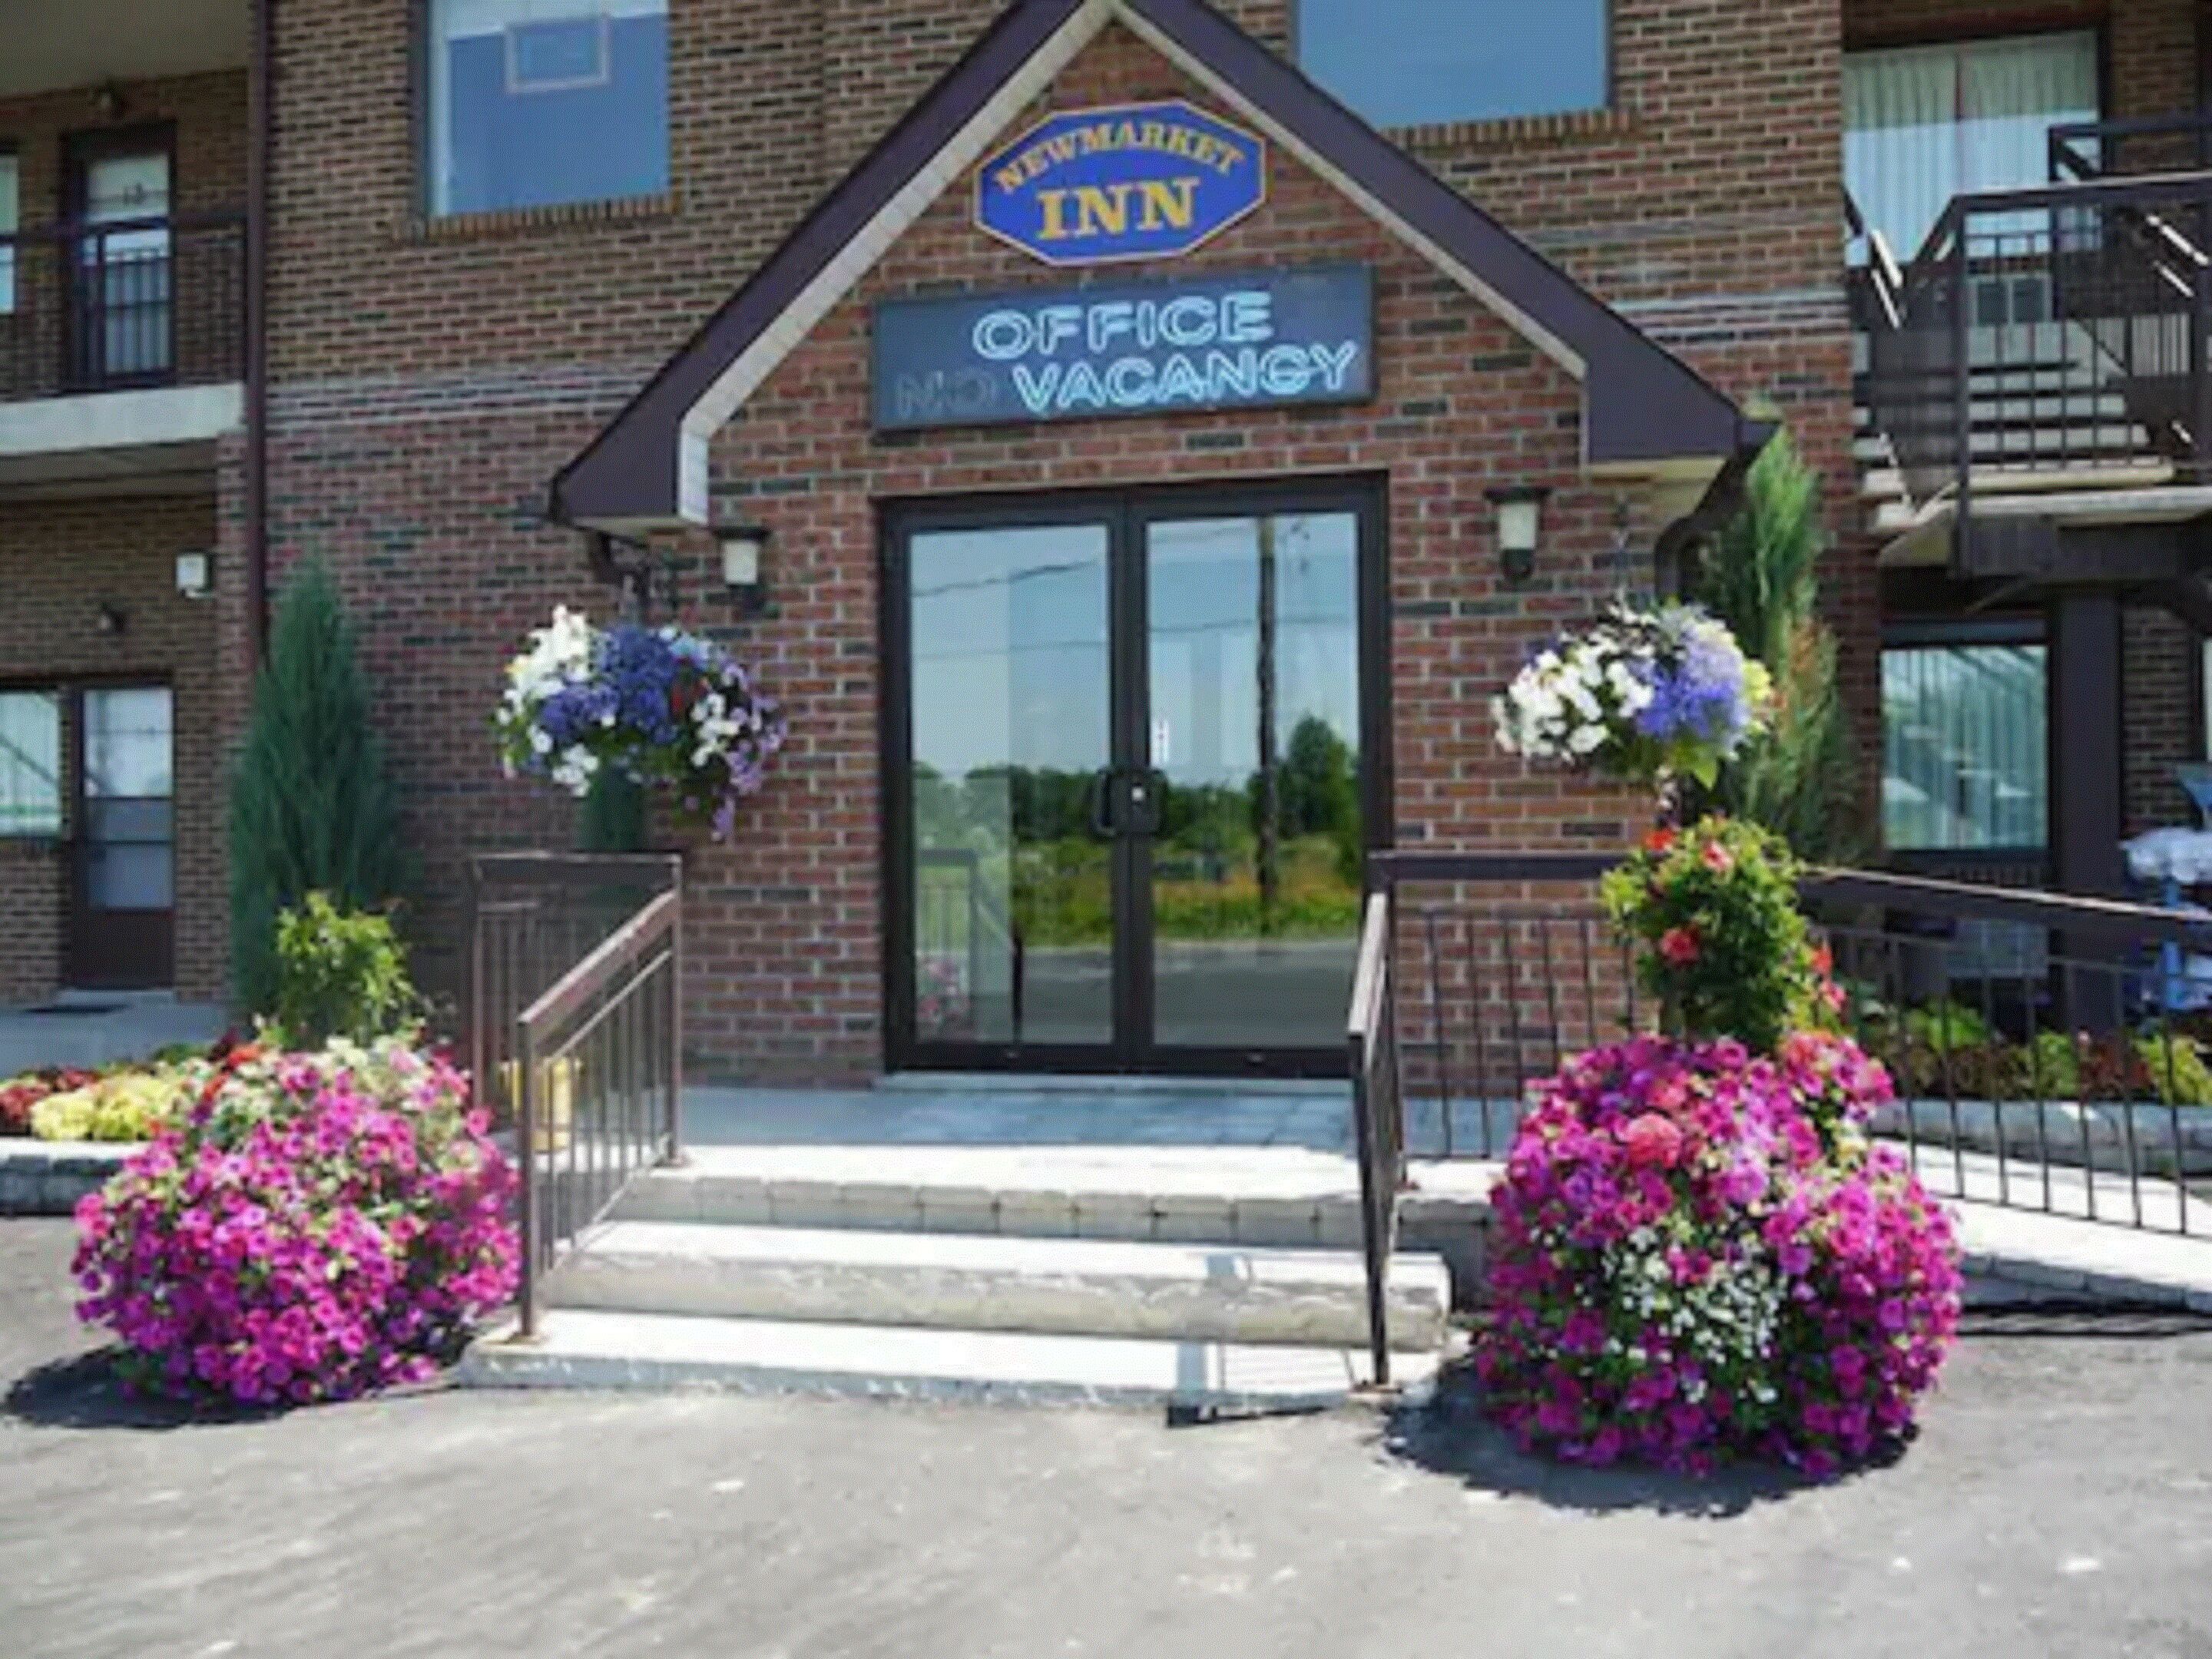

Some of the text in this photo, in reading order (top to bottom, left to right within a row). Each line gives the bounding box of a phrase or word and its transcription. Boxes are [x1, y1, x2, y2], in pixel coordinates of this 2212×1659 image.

[993, 122, 1245, 194] NEWMARKET
[1037, 177, 1200, 240] INN
[972, 290, 1274, 360] OFFICE
[1012, 339, 1358, 415] VACANCY
